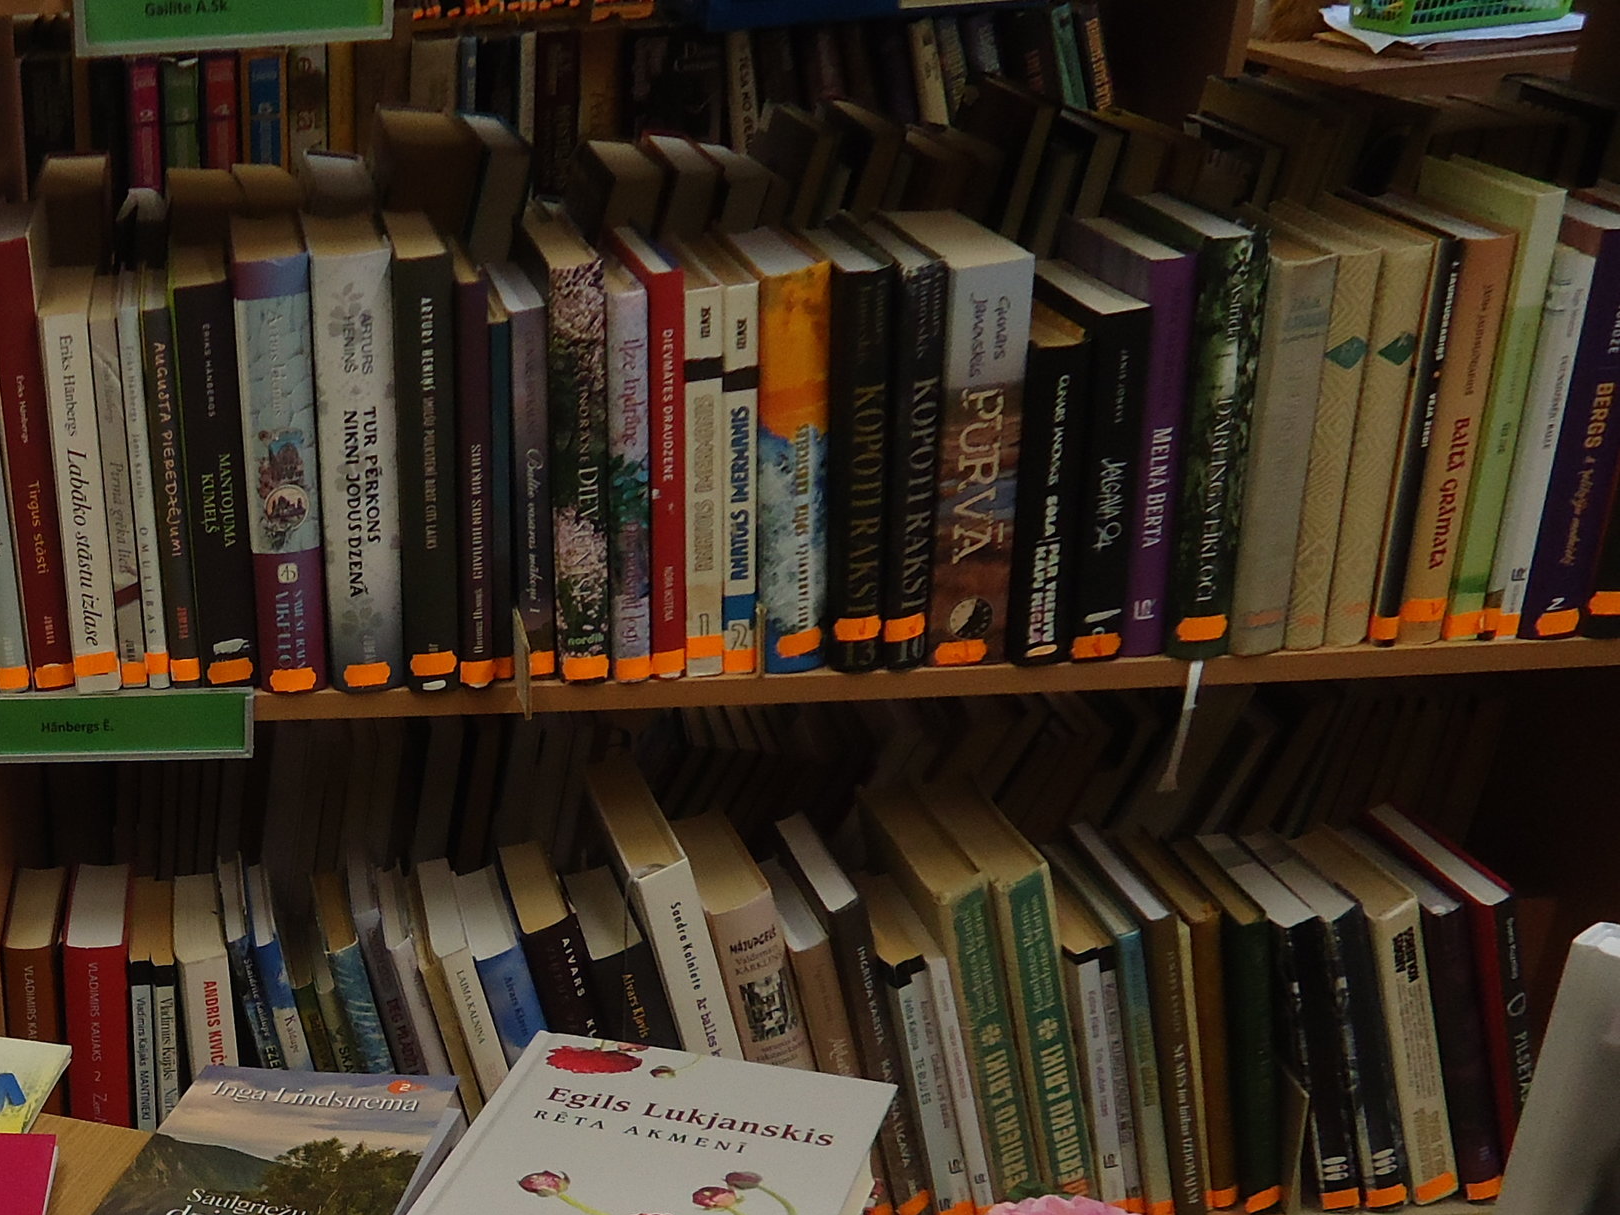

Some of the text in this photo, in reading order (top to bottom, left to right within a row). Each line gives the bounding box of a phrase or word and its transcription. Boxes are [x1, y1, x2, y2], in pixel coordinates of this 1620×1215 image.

[344, 411, 360, 464] NIKNI
[662, 405, 675, 482] DRAUDZENE
[28, 481, 42, 528] Tirgus
[67, 449, 92, 527] Labāko
[218, 453, 237, 548] MANTOJUMA
[362, 407, 381, 544] TUR PĒRKONS
[1141, 426, 1174, 548] MELNA BERTA
[75, 532, 94, 589] stāstu
[348, 538, 370, 598] DZENĀ
[81, 594, 103, 646] izlase
[87, 962, 100, 1017] VLADIMIRS
[561, 937, 586, 998] AIVARS
[203, 980, 220, 1027] ANDRIS
[211, 1080, 419, 1113] Inga Lindstrema
[546, 1086, 835, 1147] Egils Lukjanskis
[533, 1109, 749, 1155] RĒTA AKMENĪ
